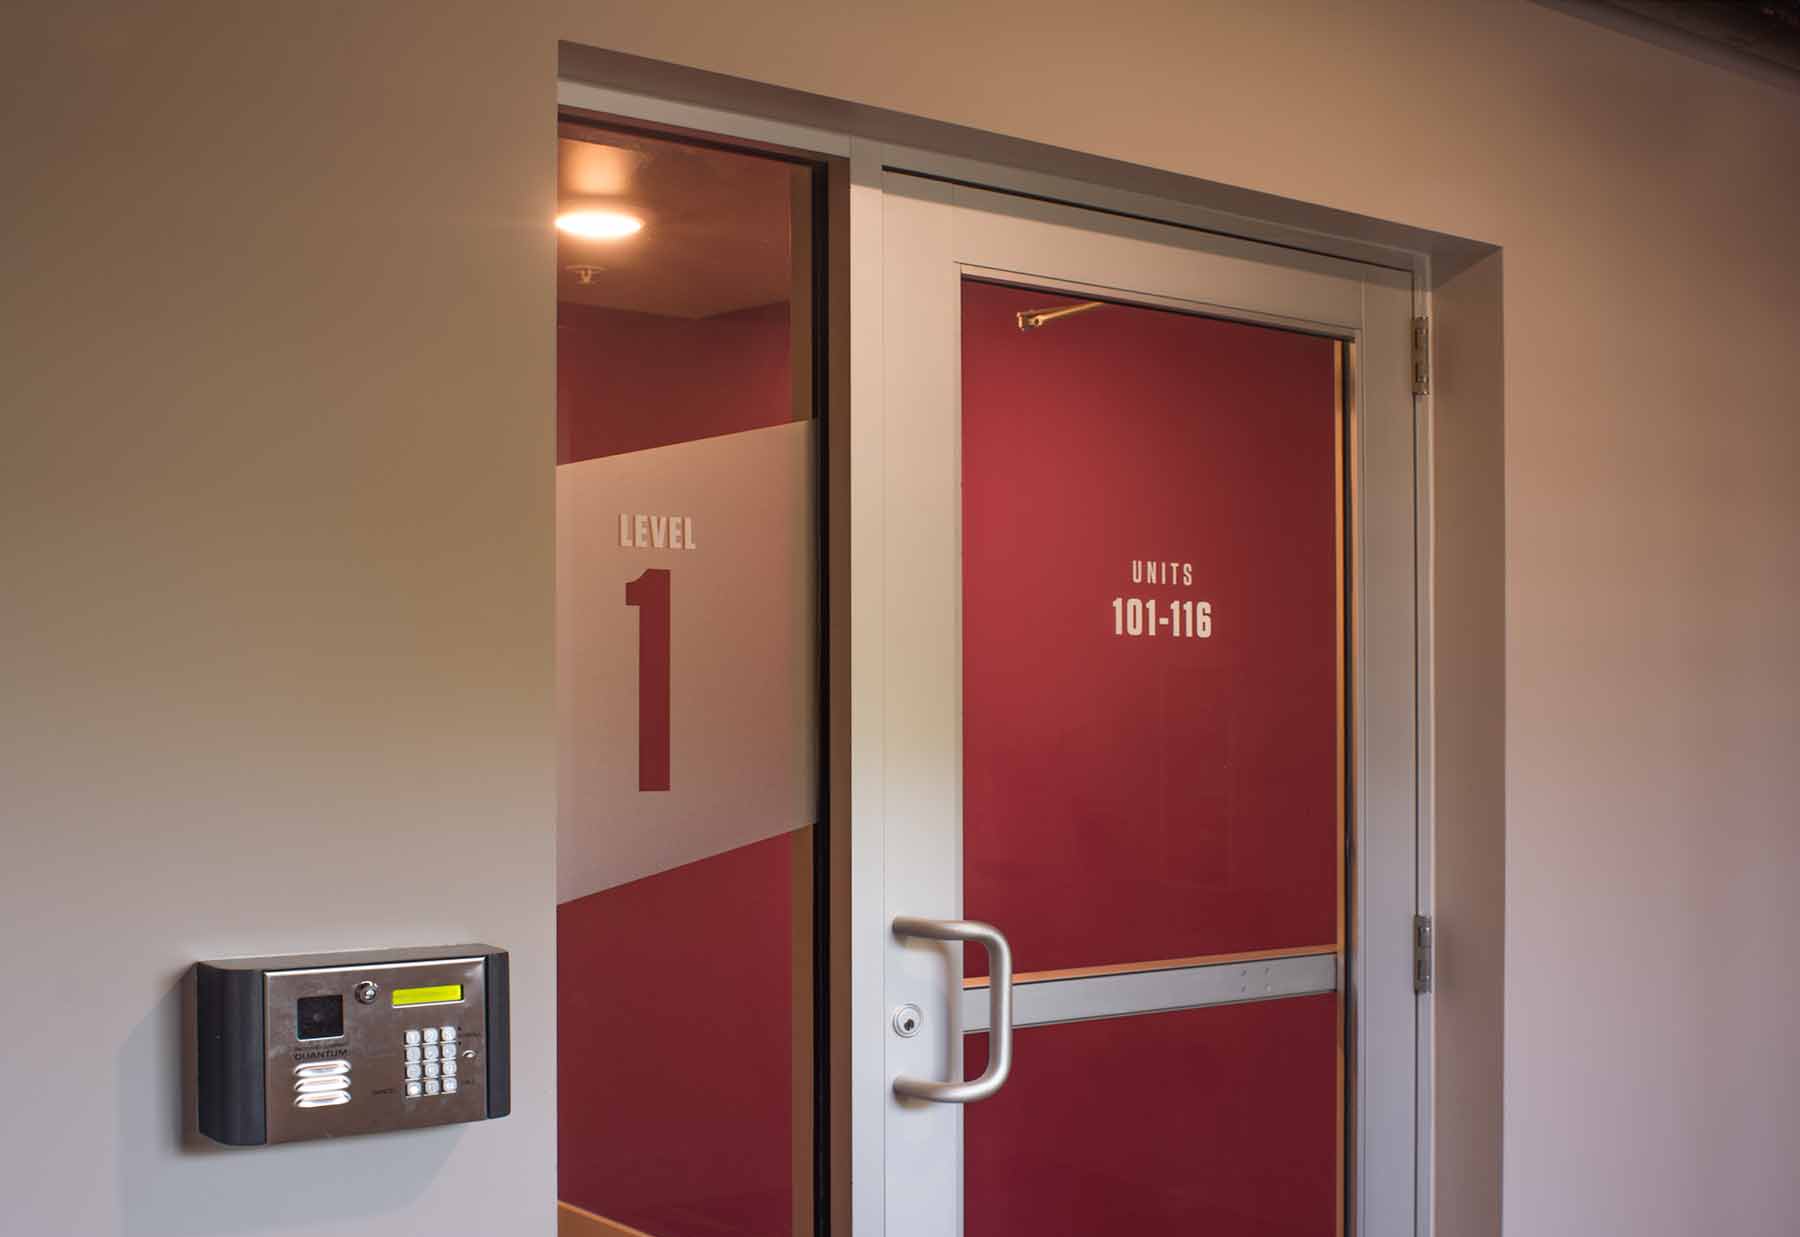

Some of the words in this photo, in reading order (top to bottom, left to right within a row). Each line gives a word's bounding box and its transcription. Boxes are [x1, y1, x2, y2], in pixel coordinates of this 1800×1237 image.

[618, 512, 697, 551] LEVEL
[1131, 559, 1193, 586] UNITS
[1112, 597, 1212, 639] 101-116
[625, 568, 671, 791] 1
[294, 1048, 348, 1061] QUANTUM
